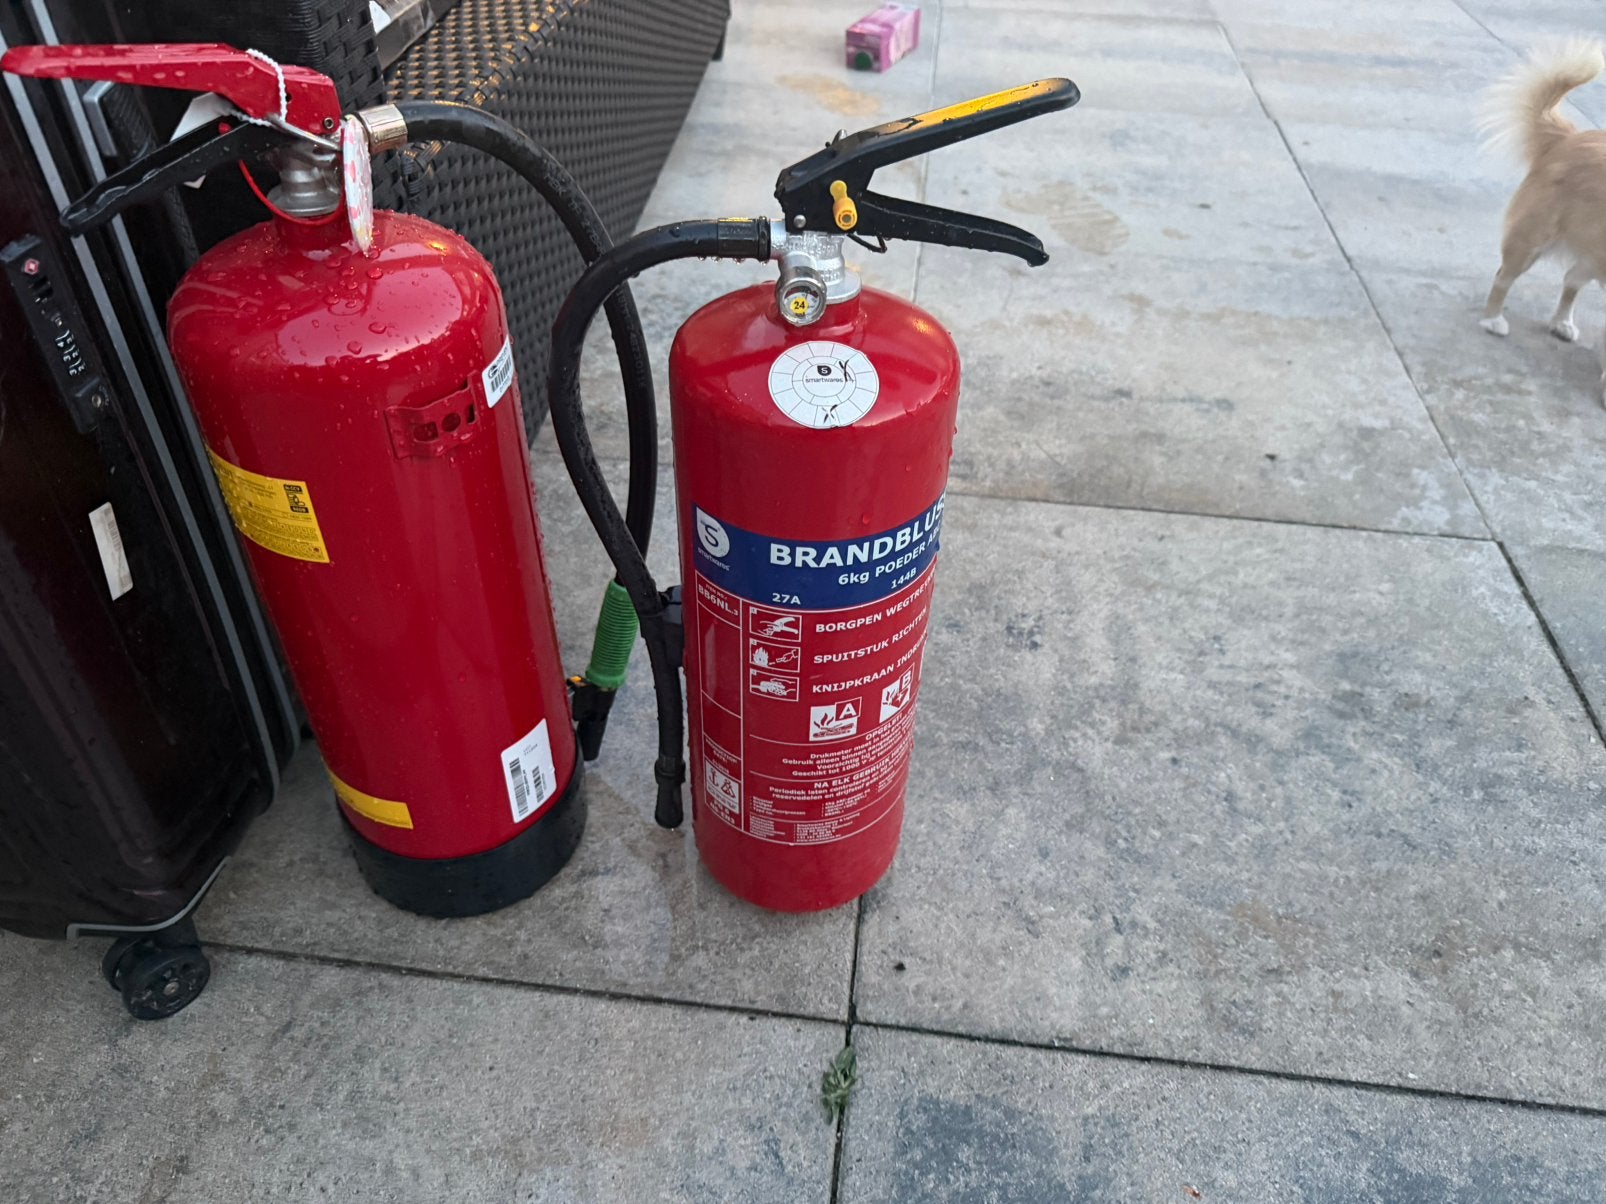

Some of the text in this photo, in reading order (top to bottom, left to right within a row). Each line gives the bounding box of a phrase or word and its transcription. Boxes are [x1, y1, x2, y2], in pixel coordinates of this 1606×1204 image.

[794, 301, 805, 309] 24
[838, 572, 869, 585] 6kg
[875, 542, 925, 577] POEDER
[891, 567, 916, 589] 144B
[772, 592, 801, 605] 27A
[815, 613, 882, 633] BORGPEN
[813, 604, 927, 663] SPUITSTUK RICHTEN
[812, 665, 894, 693] KNIJPKRAAN
[839, 703, 856, 720] A
[810, 748, 852, 759] Drukmeter
[816, 756, 840, 764] alleen
[814, 758, 890, 789] NA ELK GEBRUIK
